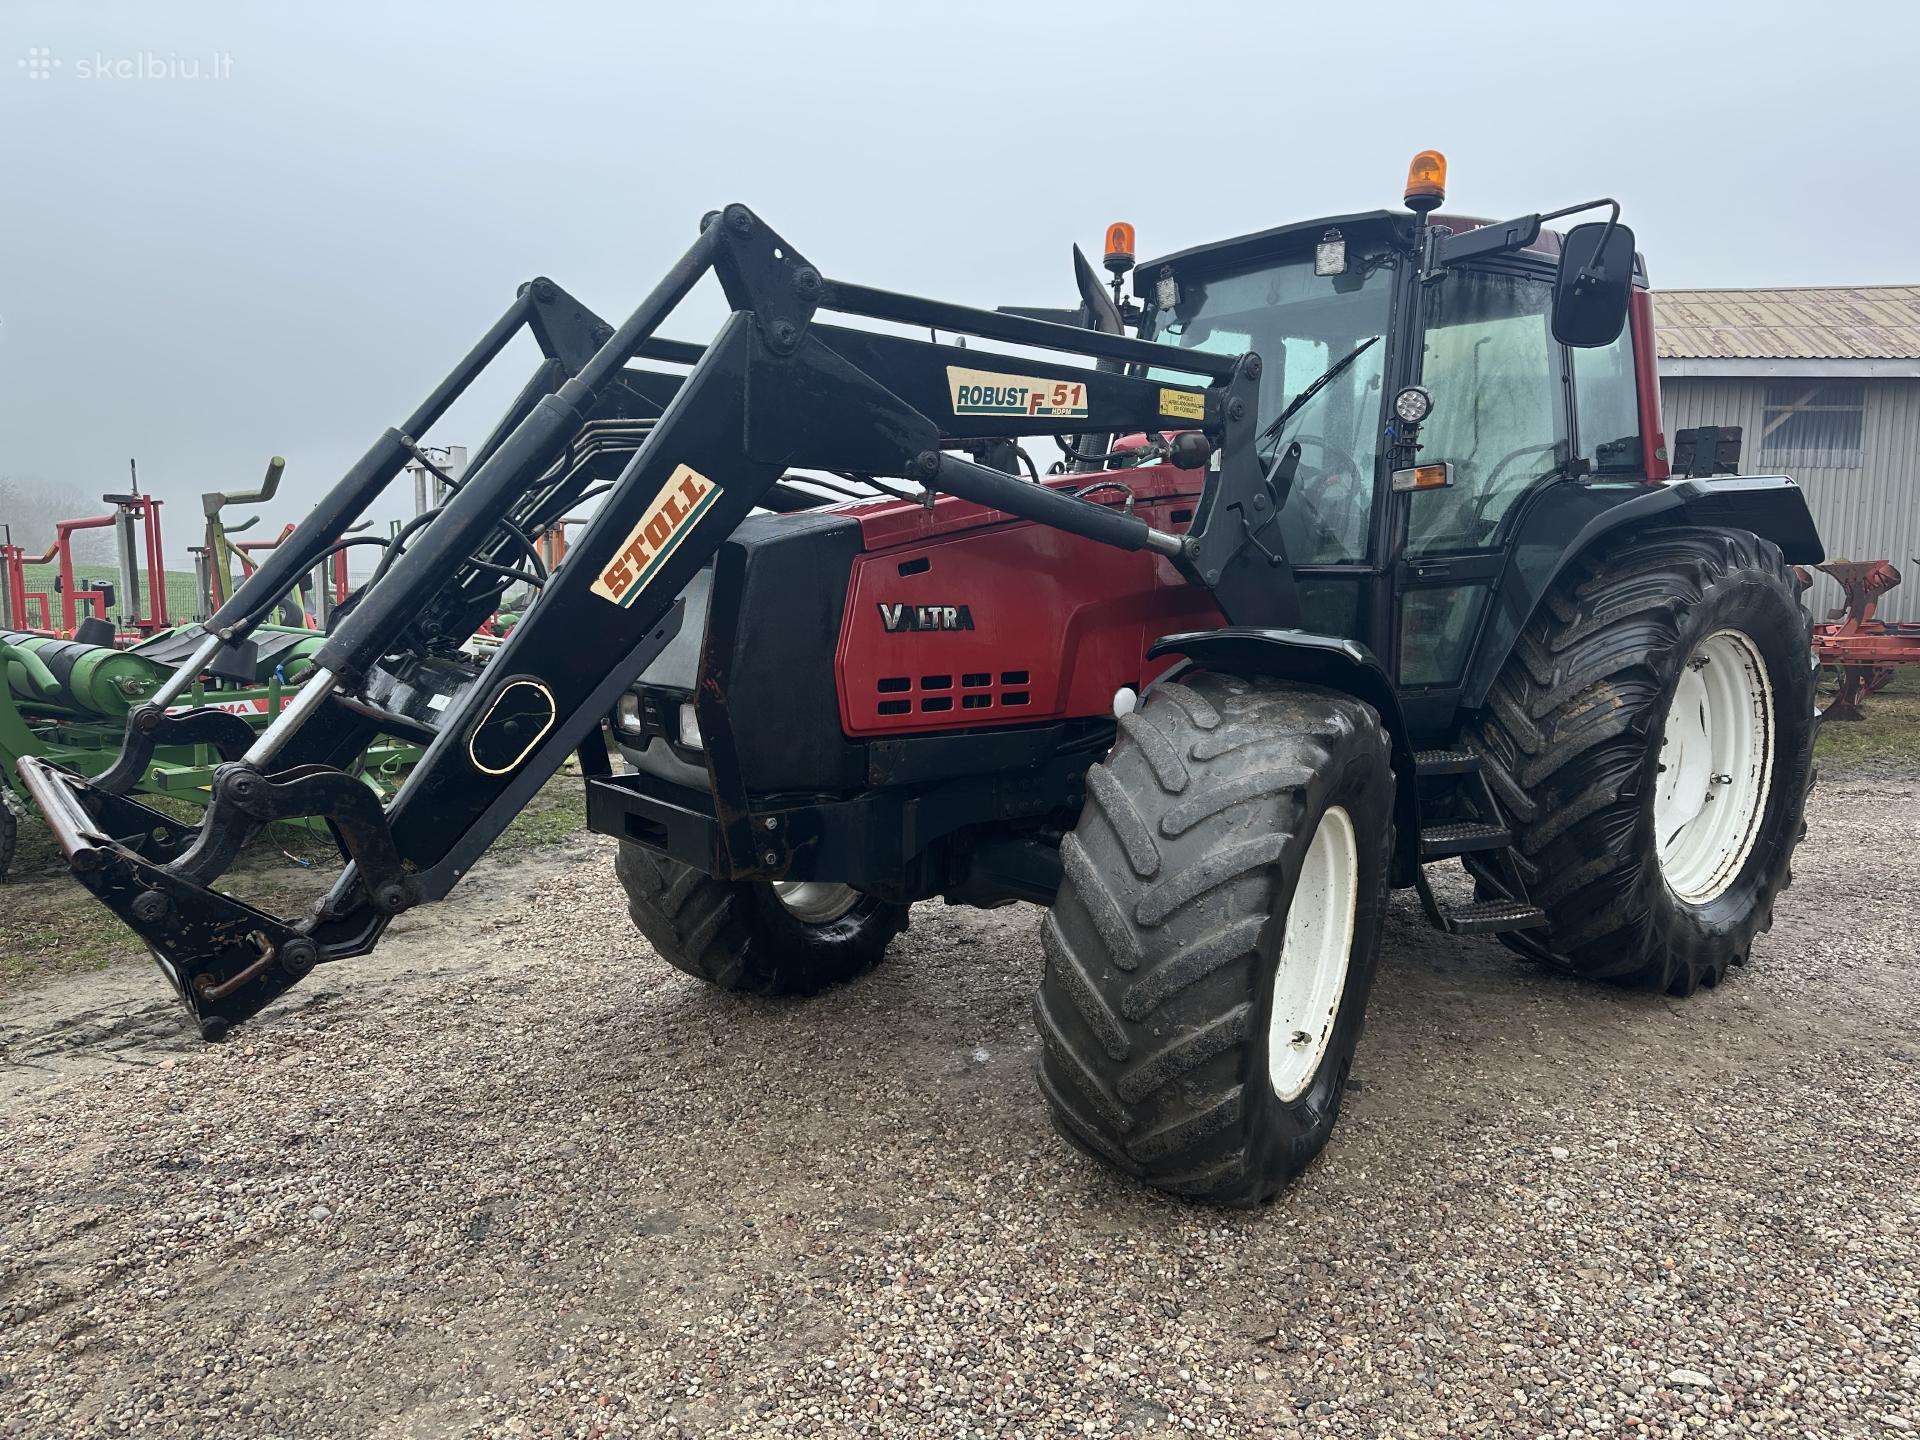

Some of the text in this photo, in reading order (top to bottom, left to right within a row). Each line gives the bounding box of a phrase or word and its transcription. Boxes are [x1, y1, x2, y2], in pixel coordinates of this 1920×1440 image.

[957, 384, 1082, 416] ROBUST F 51
[604, 475, 706, 599] STOLL
[878, 603, 976, 632] VALTRA
